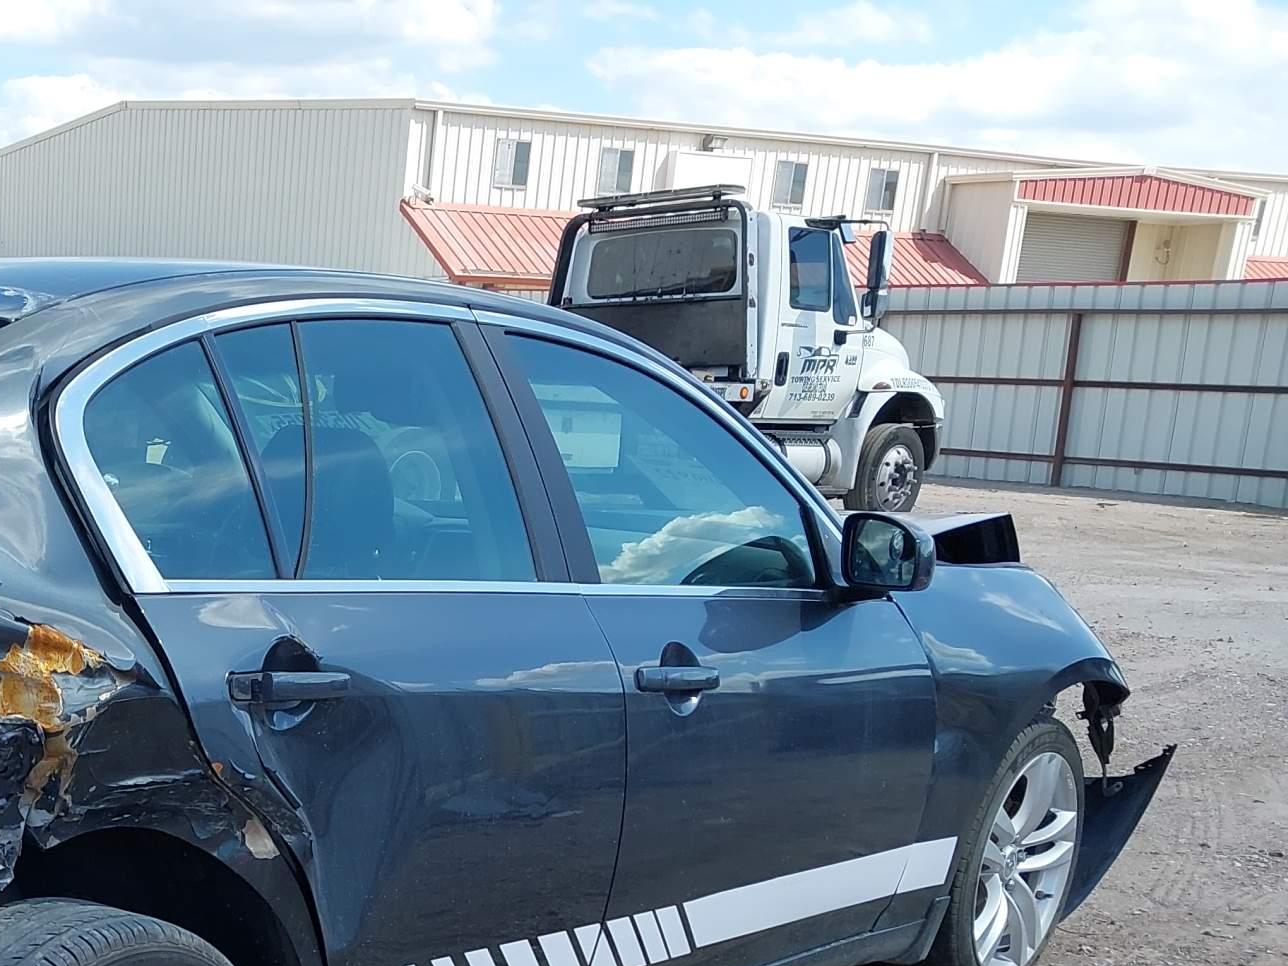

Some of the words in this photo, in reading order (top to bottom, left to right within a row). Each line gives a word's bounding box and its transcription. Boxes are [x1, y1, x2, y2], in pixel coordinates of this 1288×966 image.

[800, 359, 838, 375] MPR
[791, 375, 815, 384] TOWING
[816, 375, 841, 383] SERVICE
